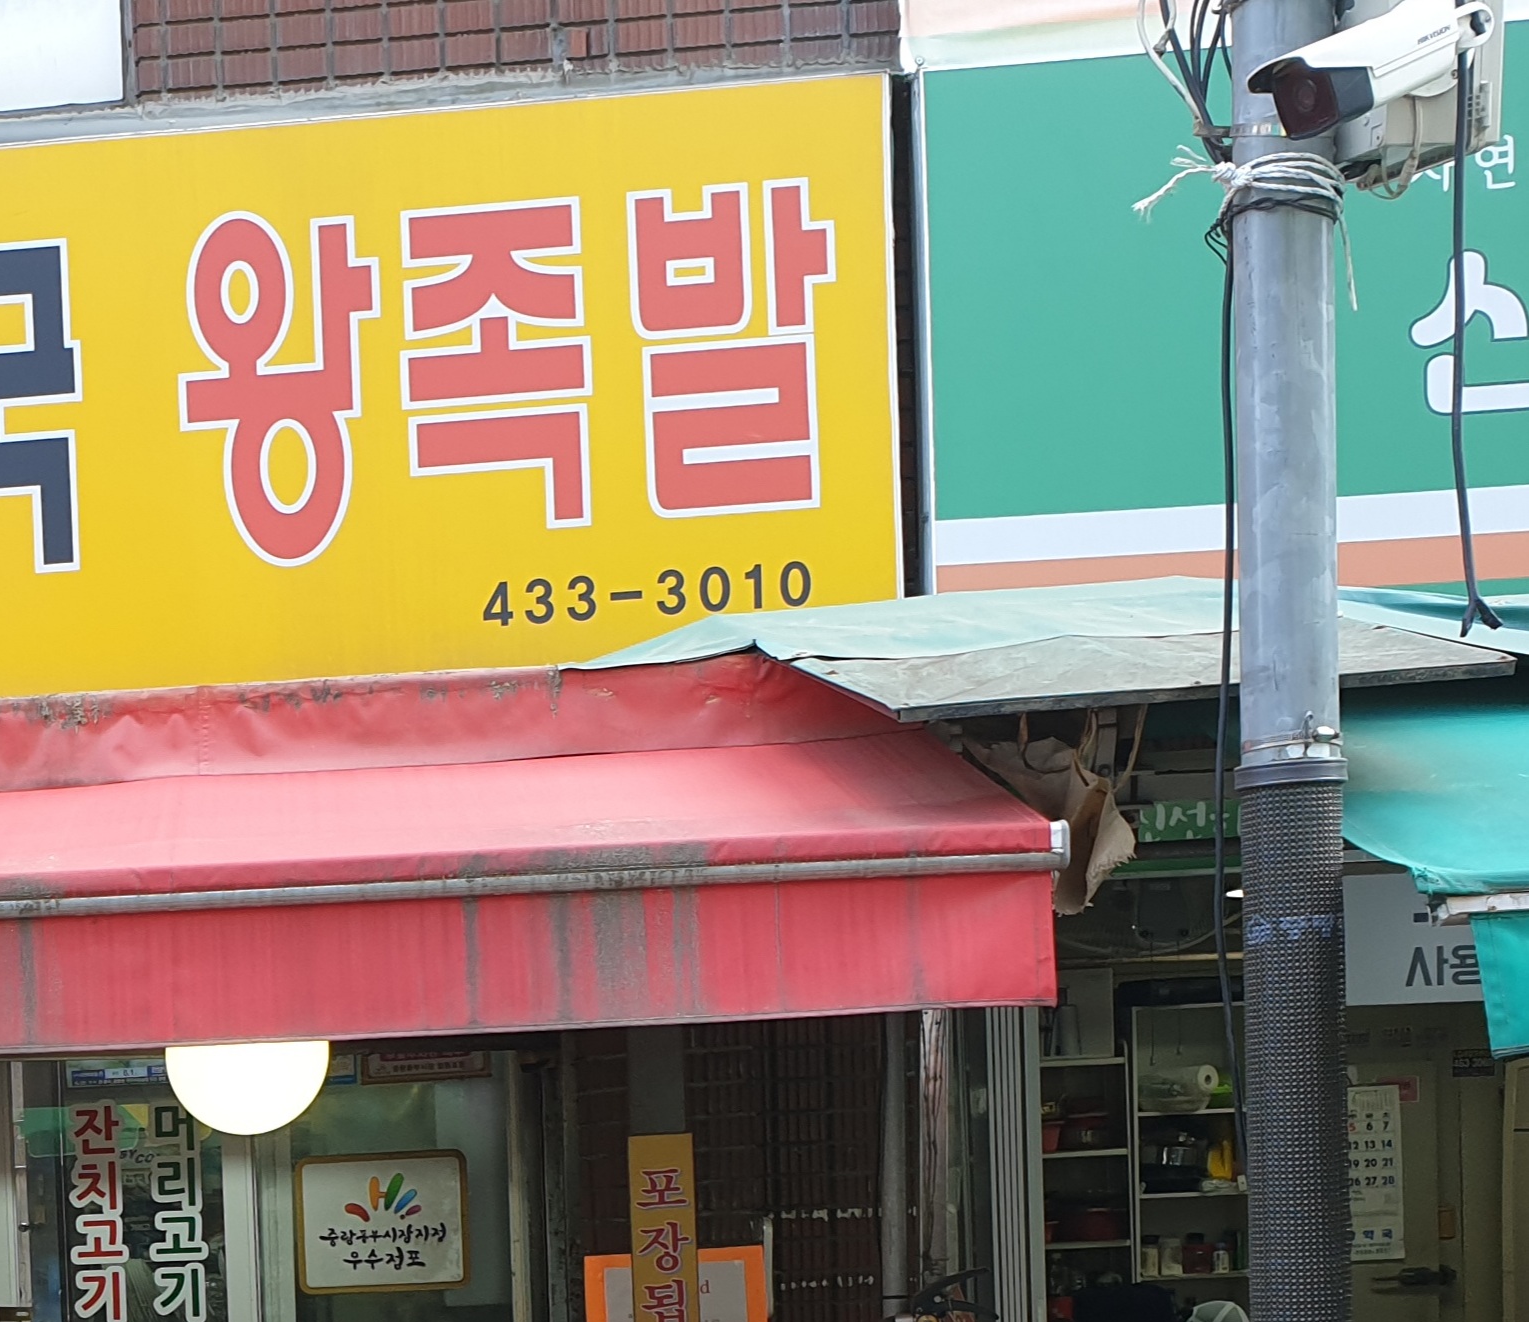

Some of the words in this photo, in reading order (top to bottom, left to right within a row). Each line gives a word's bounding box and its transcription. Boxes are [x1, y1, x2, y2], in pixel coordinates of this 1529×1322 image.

[178, 176, 836, 568] 왕족발
[482, 560, 812, 627] 433-3010
[152, 1105, 208, 1322] 머리고기
[342, 1247, 427, 1271] 우수점포
